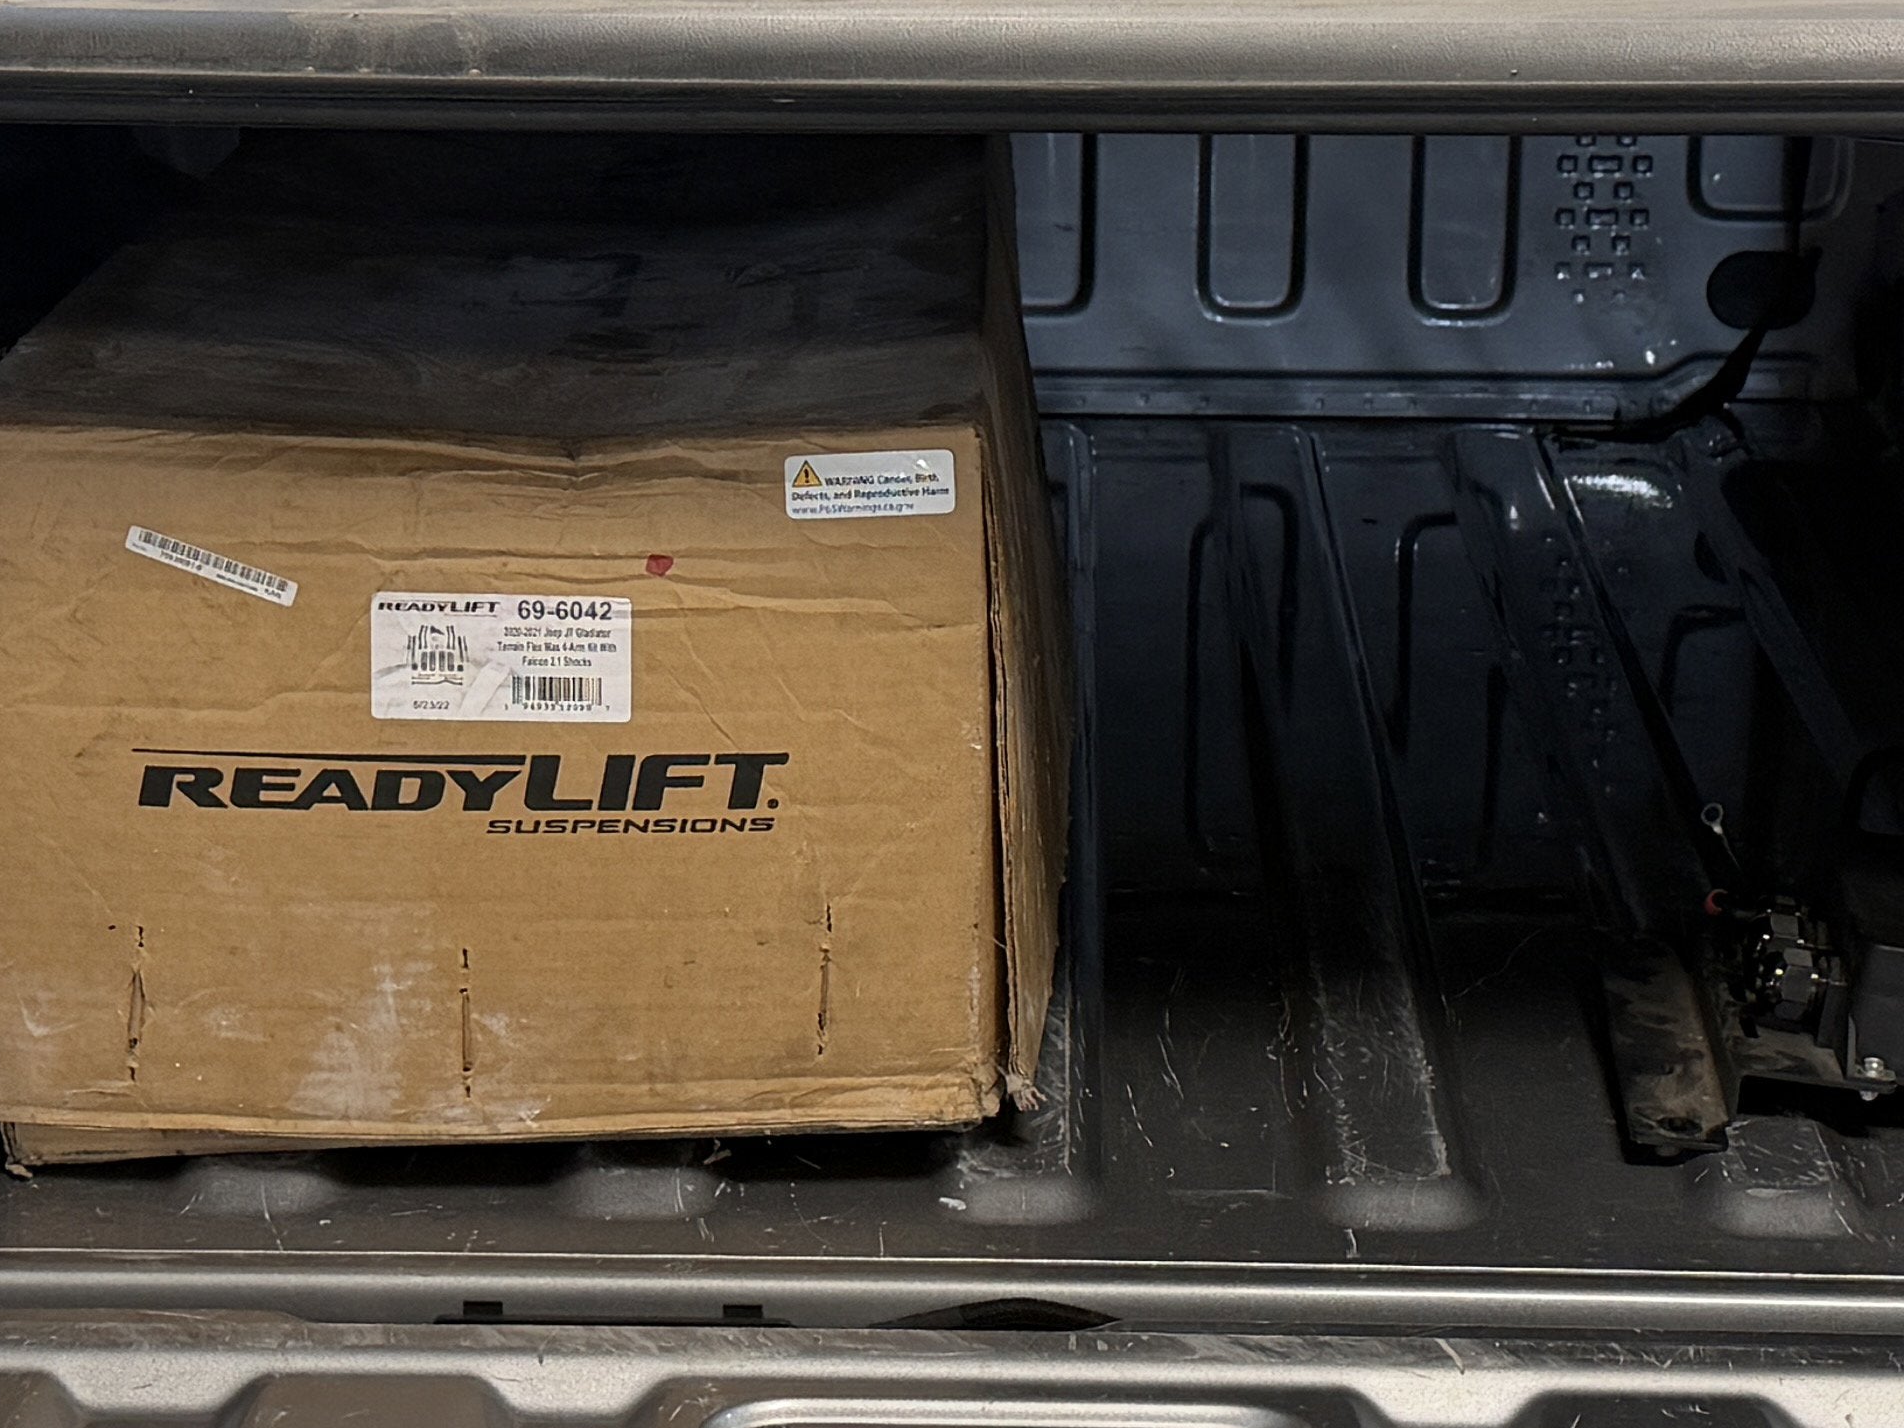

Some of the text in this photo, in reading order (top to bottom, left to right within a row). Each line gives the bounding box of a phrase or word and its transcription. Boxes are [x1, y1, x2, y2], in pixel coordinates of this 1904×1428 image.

[377, 599, 613, 621] READYLIFT 69-6042
[486, 817, 775, 835] SUSPENSIONS
